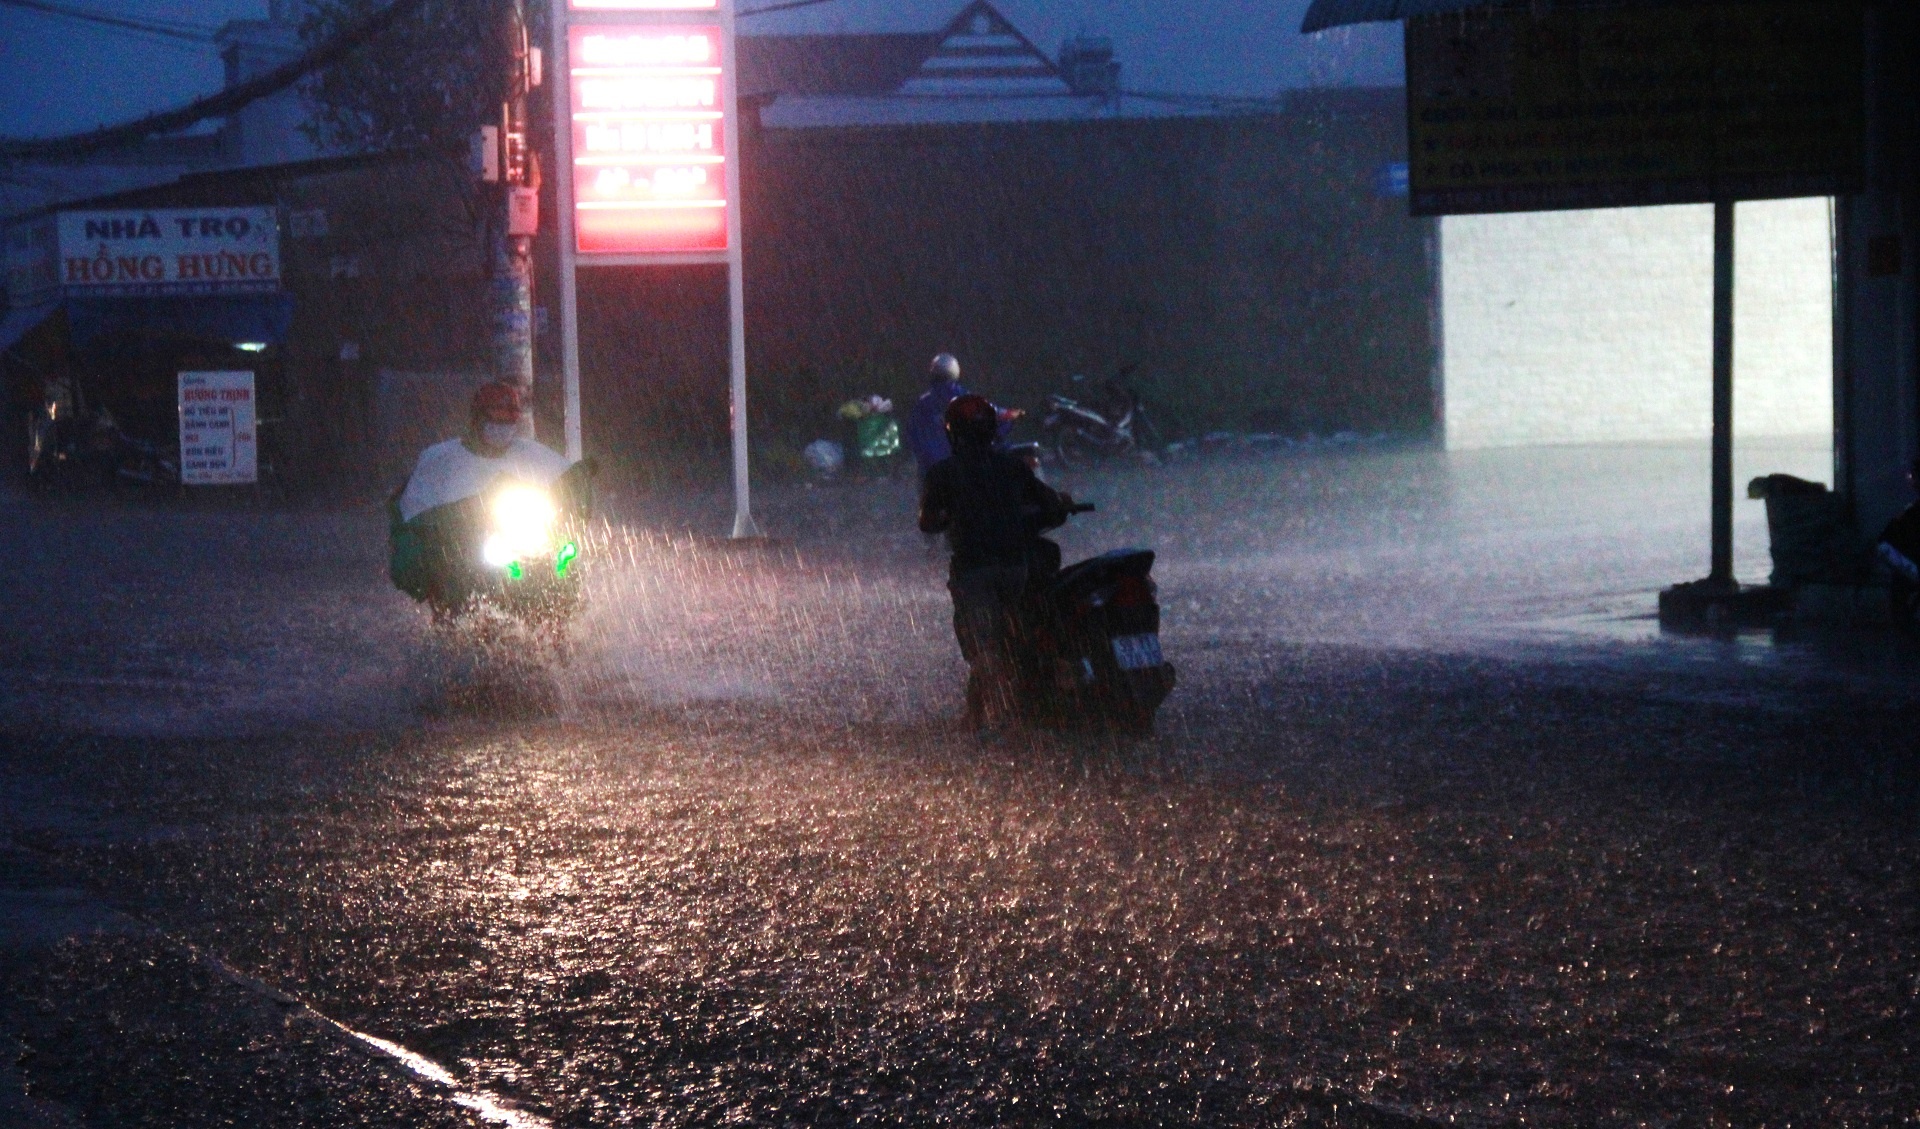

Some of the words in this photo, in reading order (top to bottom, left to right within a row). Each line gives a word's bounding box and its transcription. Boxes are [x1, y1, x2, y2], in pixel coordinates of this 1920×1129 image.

[85, 214, 162, 239] NHÀ
[174, 217, 250, 242] TRỌ
[177, 250, 273, 280] HƯNG
